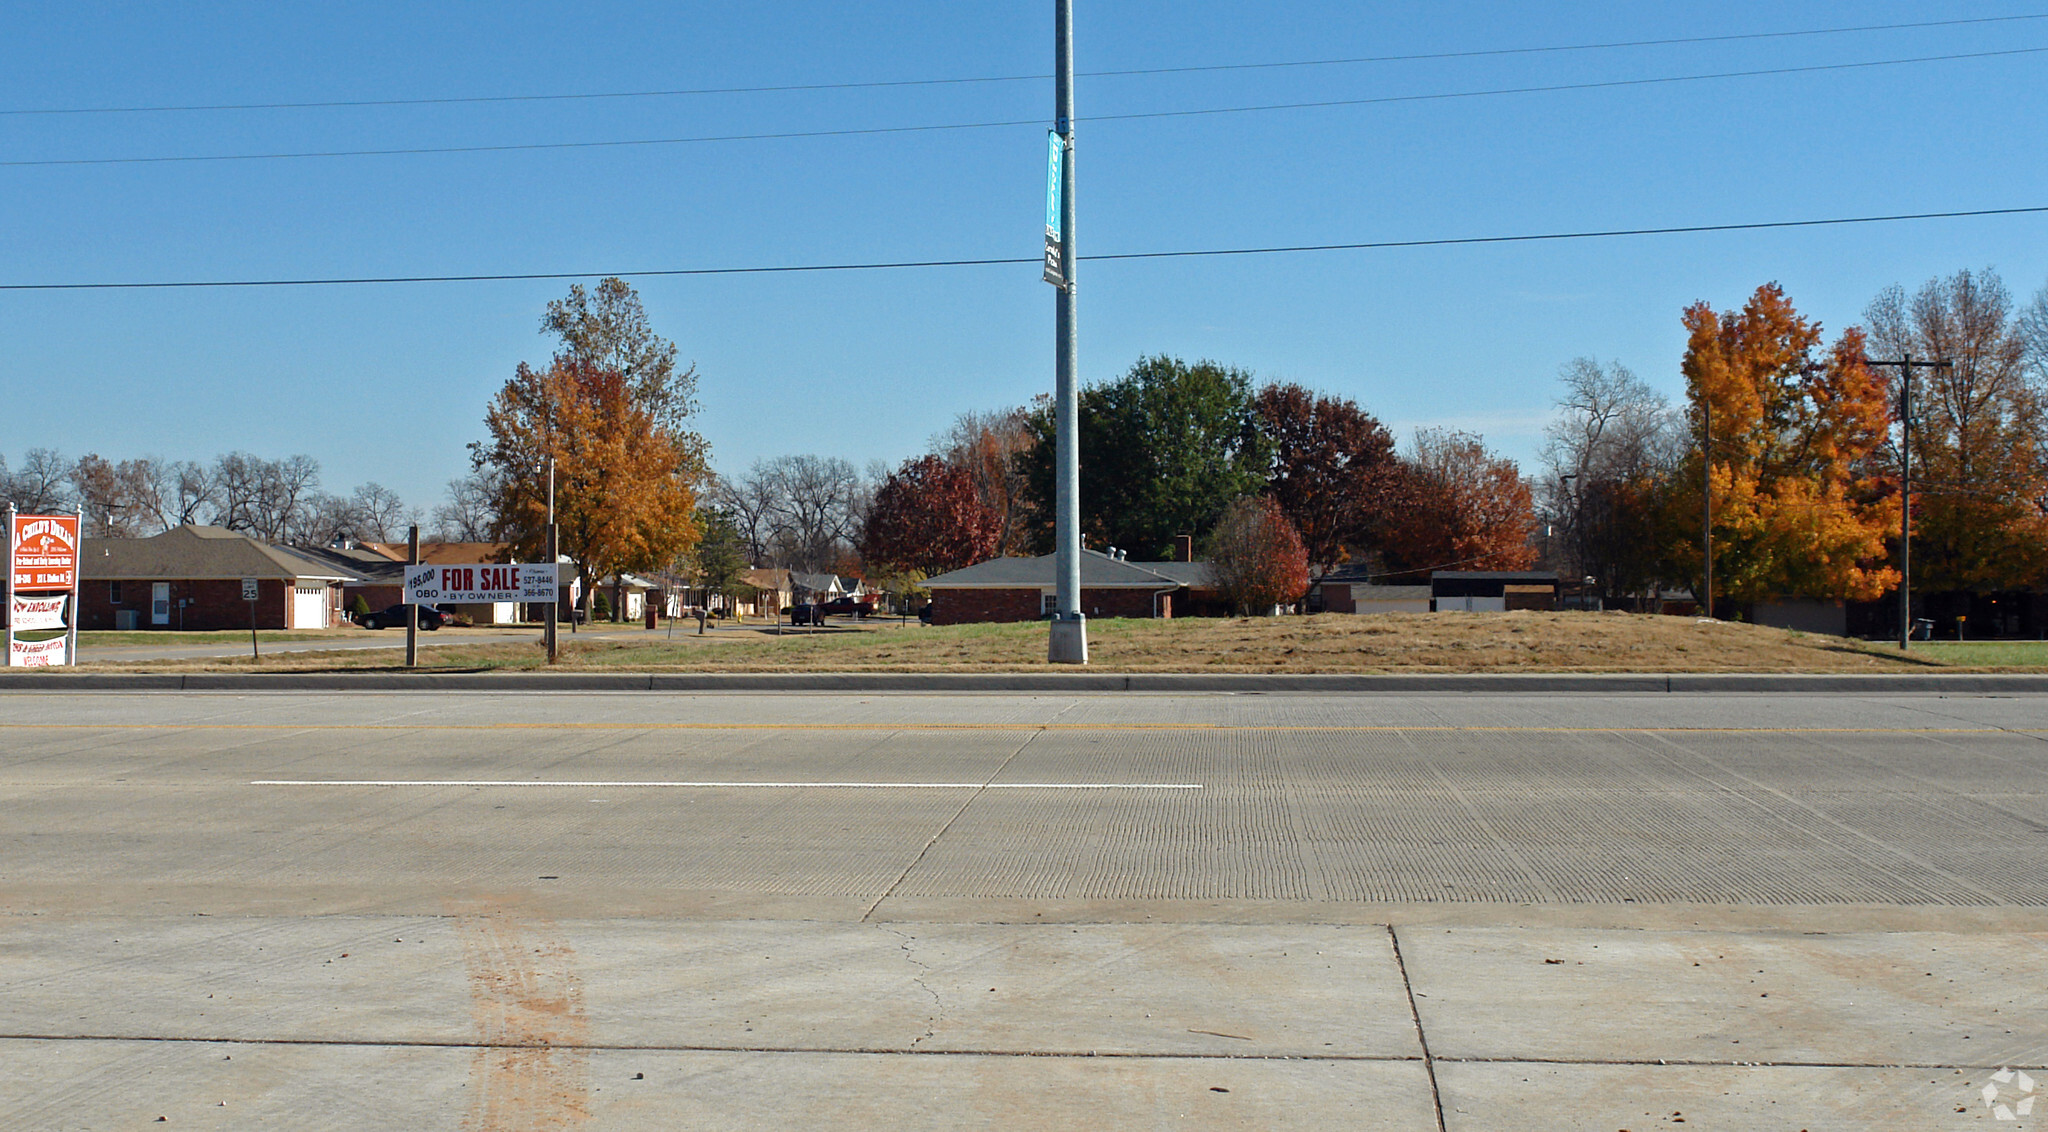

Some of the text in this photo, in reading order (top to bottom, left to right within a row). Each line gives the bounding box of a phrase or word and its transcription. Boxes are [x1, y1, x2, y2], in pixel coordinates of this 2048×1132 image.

[15, 519, 74, 551] A CHILD'S DREAM
[442, 567, 520, 591] FOR SALE
[243, 589, 257, 599] 25
[415, 589, 439, 599] OBO
[449, 592, 513, 600] BY OWNER
